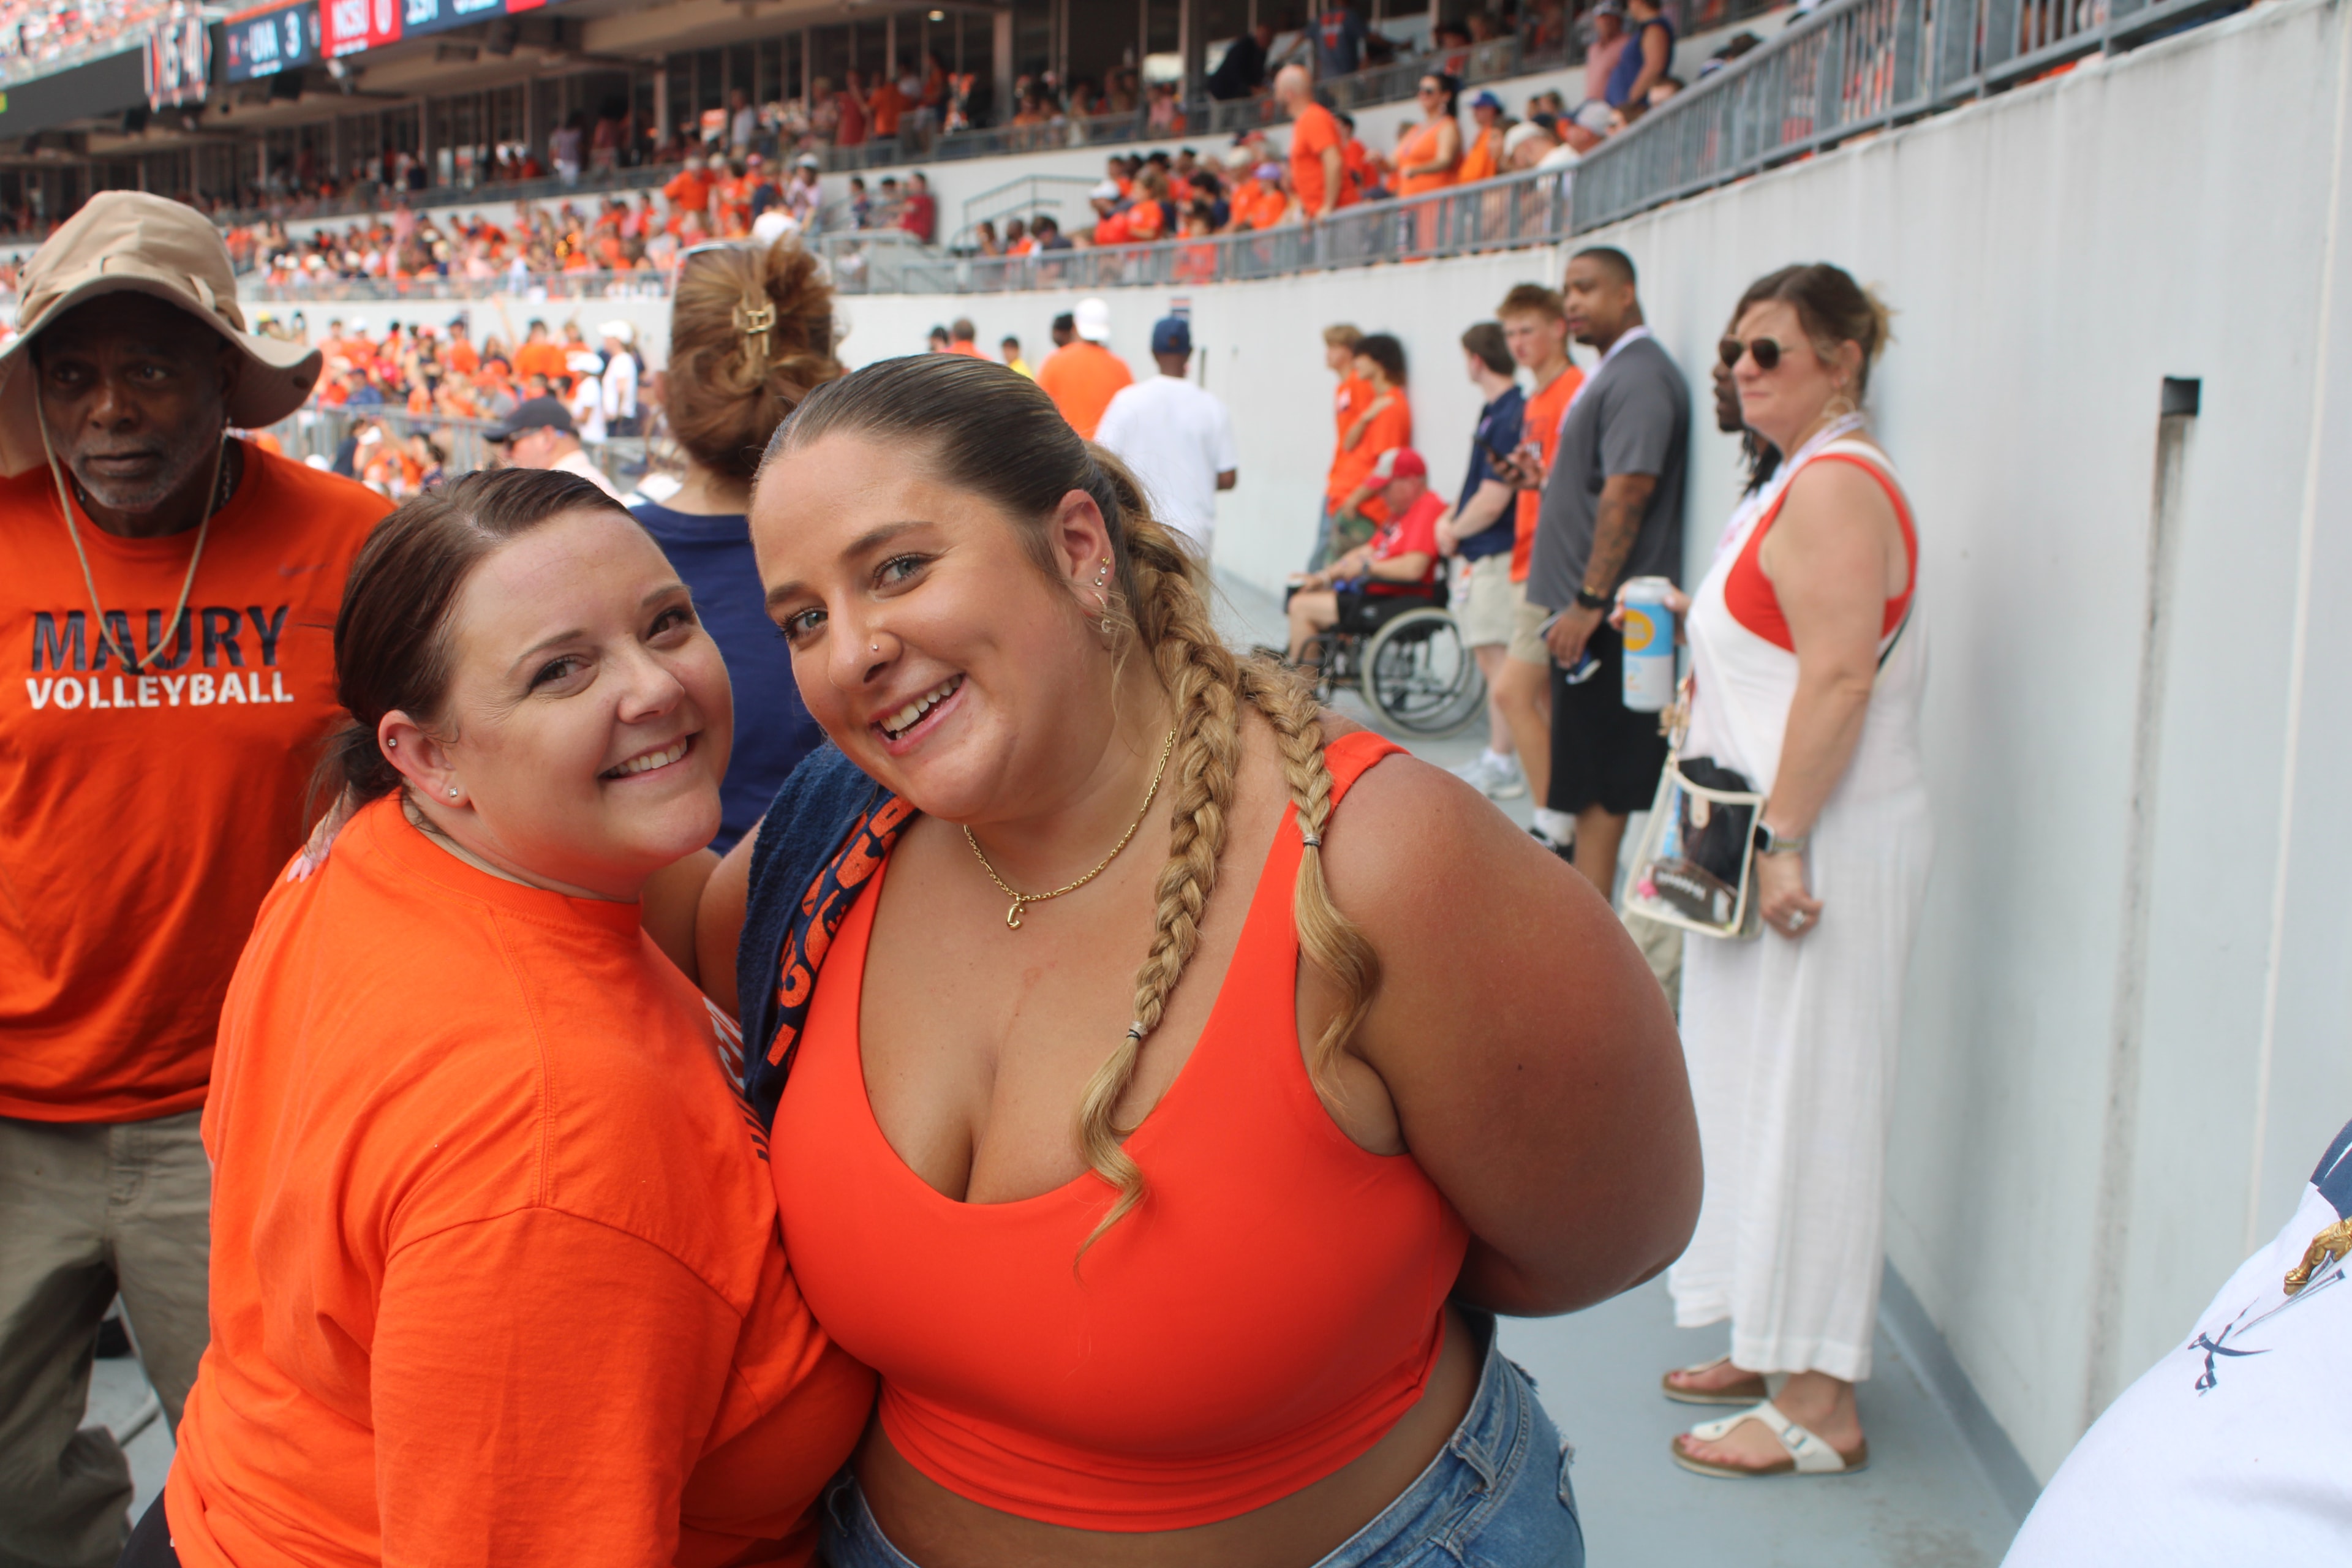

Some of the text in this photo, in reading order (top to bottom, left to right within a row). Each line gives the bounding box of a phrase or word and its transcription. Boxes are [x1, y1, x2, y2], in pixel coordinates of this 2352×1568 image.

[285, 10, 301, 58] 3
[32, 605, 289, 672] MAURY
[26, 671, 294, 710] VOLLEYBALL
